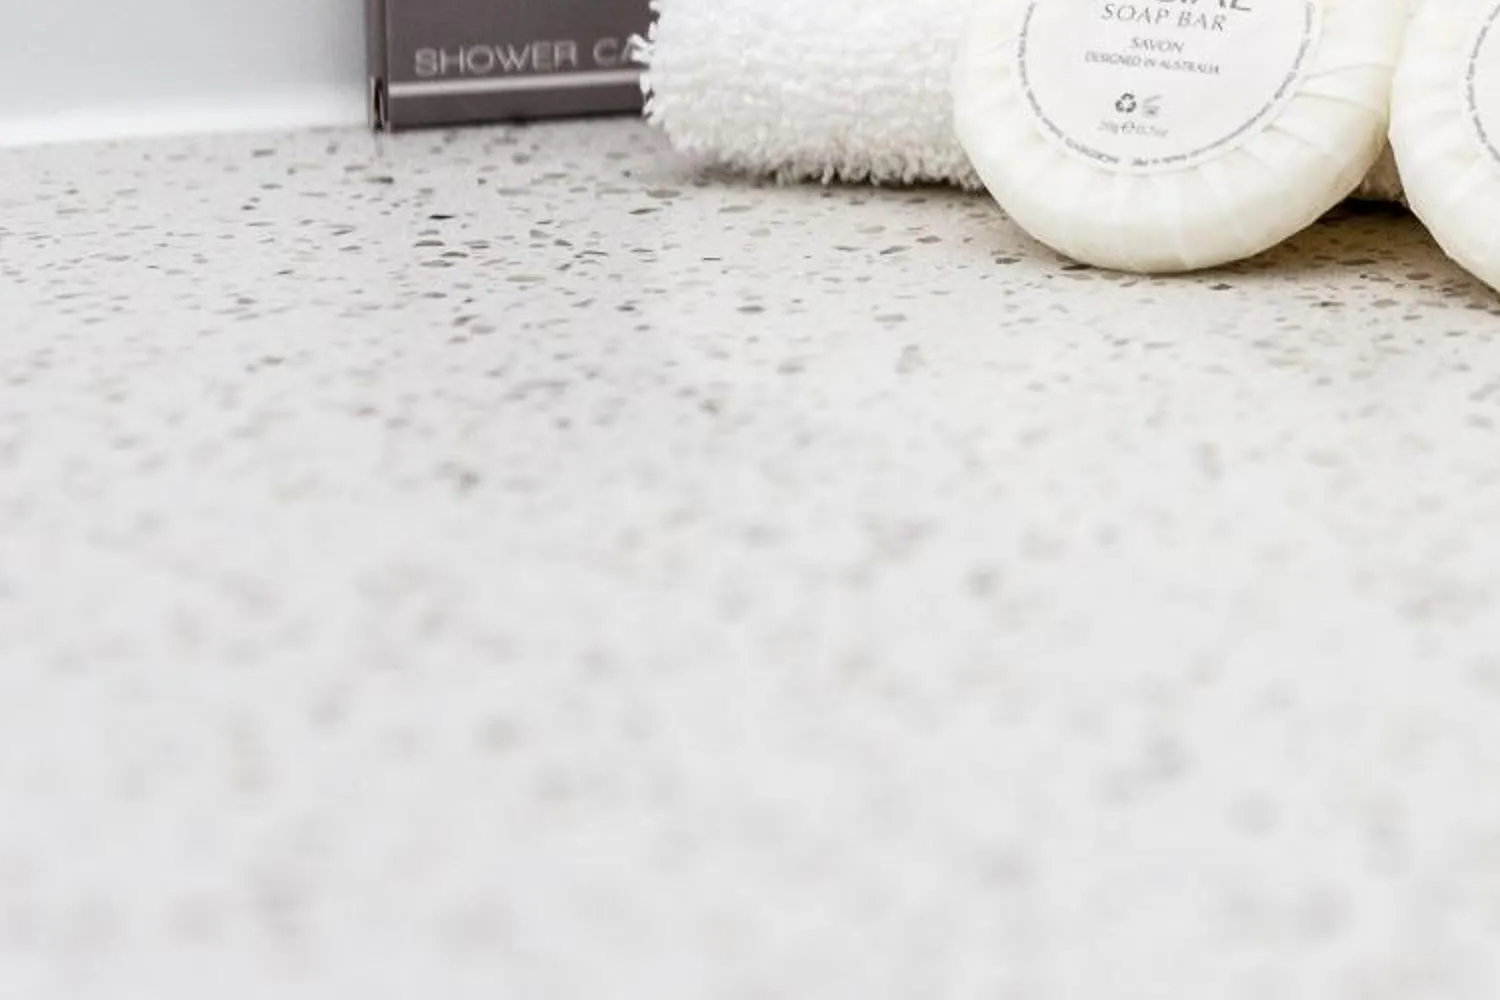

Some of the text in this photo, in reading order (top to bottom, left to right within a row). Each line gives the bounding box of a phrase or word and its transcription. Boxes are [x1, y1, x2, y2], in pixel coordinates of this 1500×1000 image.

[1101, 3, 1228, 32] SOAP BAR
[415, 39, 578, 77] SHOWER
[1131, 36, 1185, 53] SAVON
